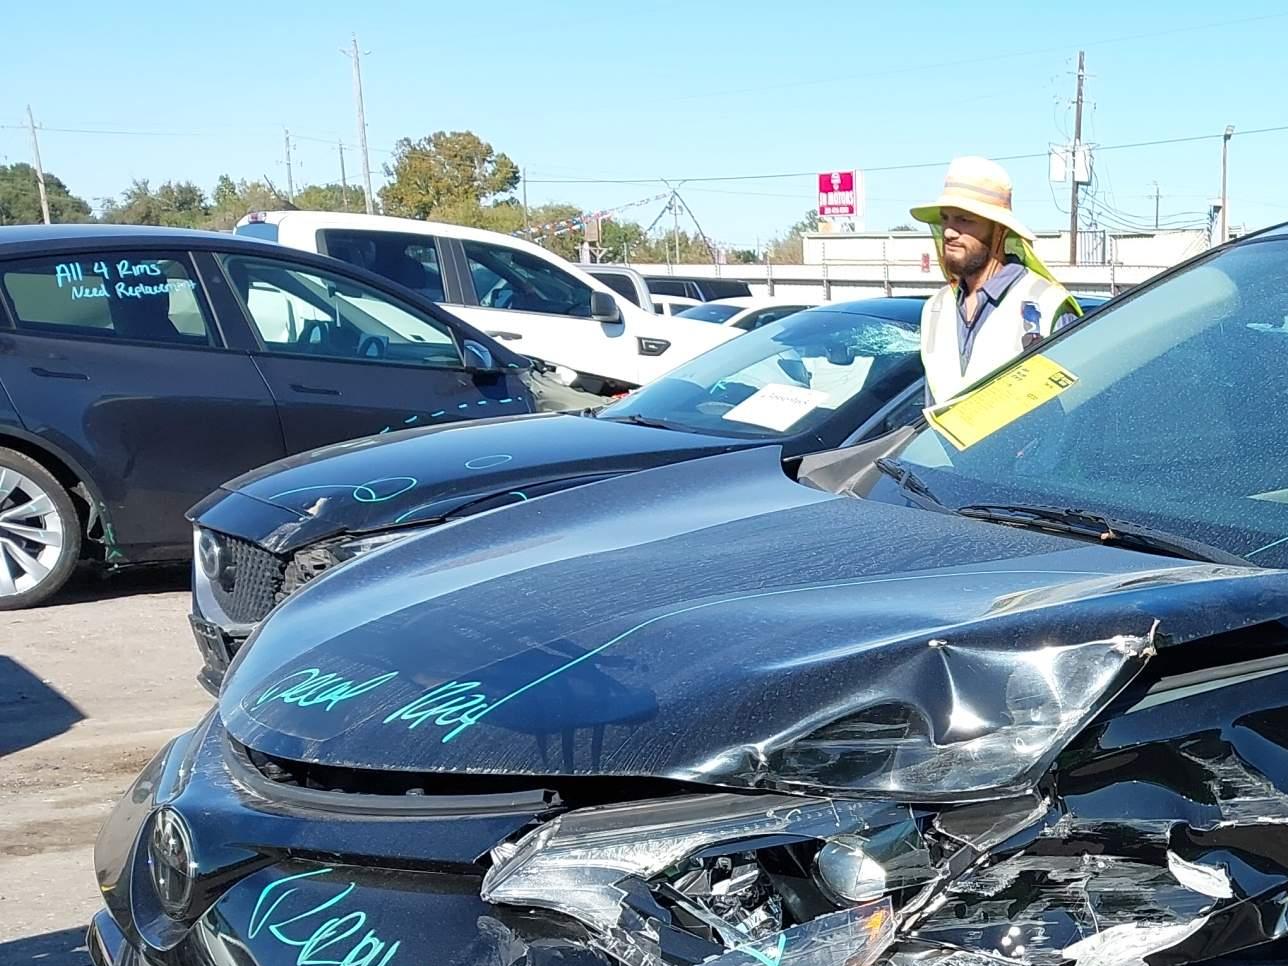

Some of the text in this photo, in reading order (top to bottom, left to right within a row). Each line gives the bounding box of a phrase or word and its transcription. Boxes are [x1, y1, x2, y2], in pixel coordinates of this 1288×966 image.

[56, 262, 83, 287] All
[94, 261, 109, 279] 4
[72, 286, 110, 300] Need
